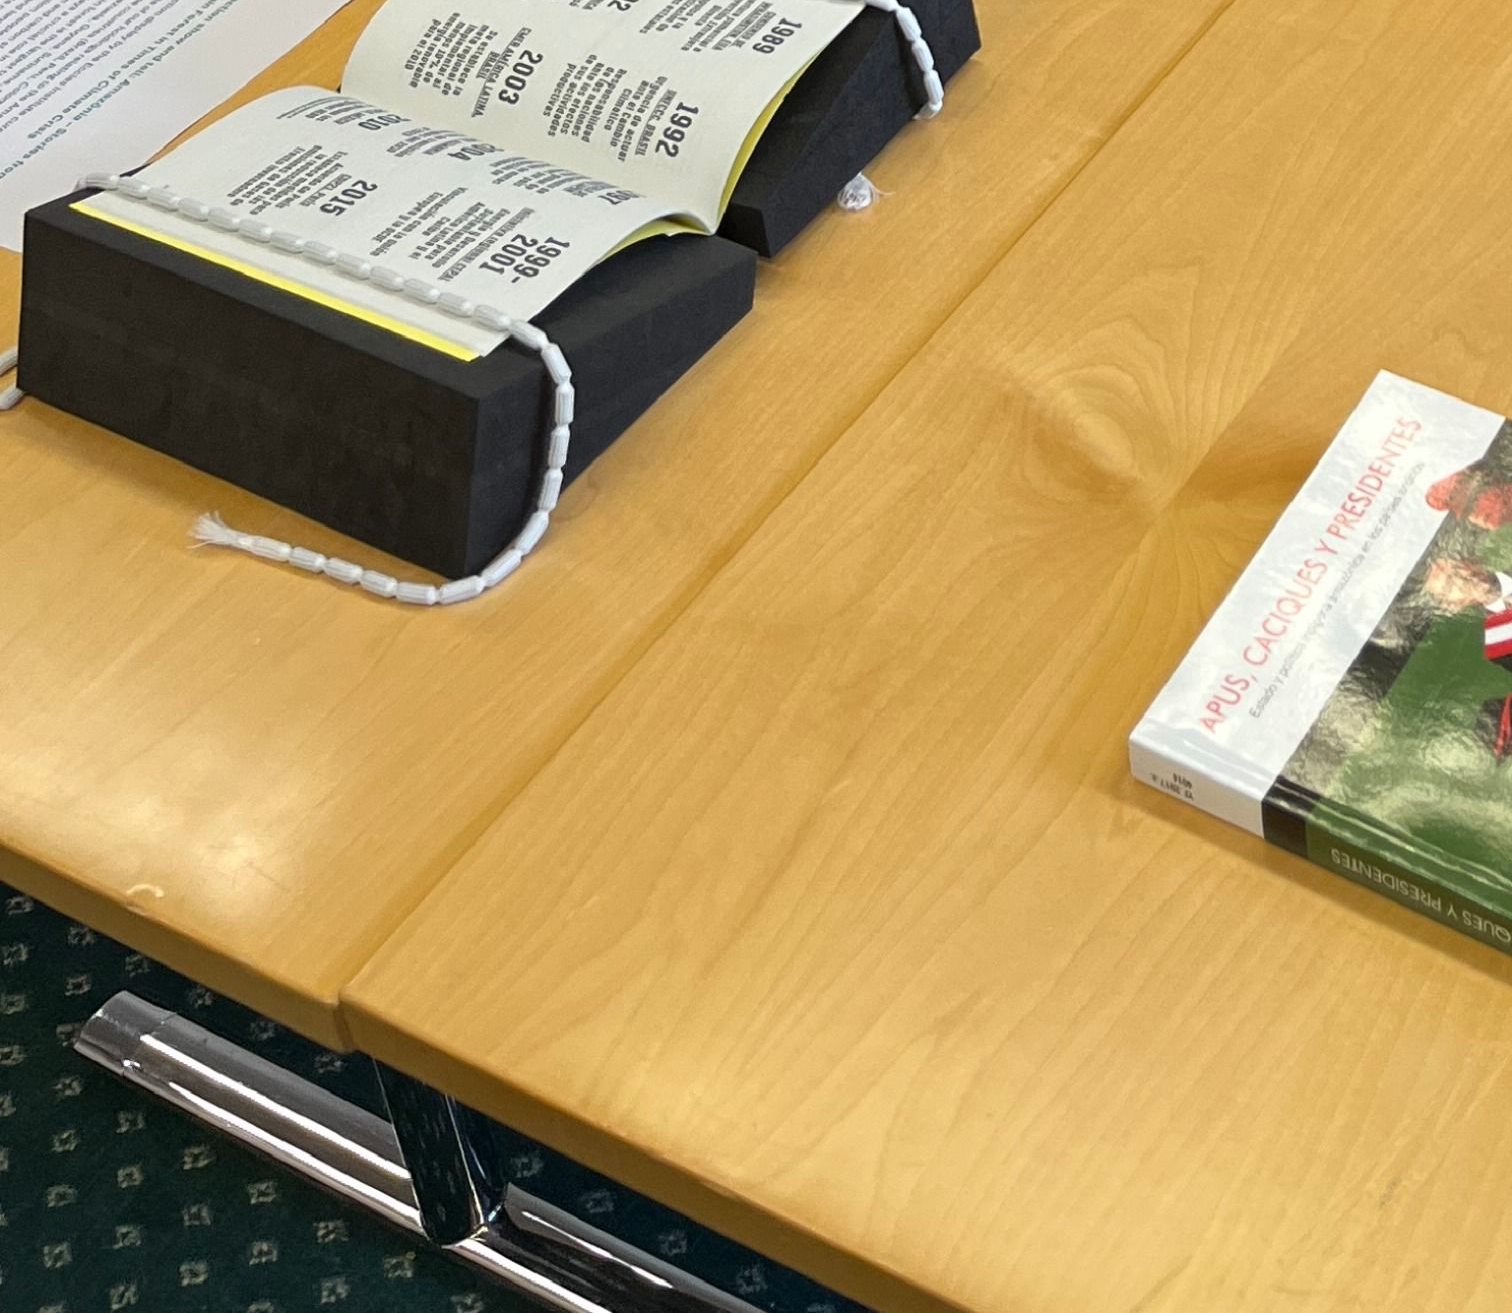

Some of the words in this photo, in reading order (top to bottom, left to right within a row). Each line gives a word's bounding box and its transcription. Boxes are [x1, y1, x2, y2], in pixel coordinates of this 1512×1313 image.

[120, 15, 155, 41] display
[166, 9, 204, 36] Forest
[175, 23, 205, 45] show
[423, 18, 442, 39] para
[467, 24, 489, 45] meta
[752, 14, 802, 54] 1989
[107, 40, 124, 50] by
[151, 44, 175, 61] and
[153, 36, 169, 44] in
[416, 38, 428, 48] el
[90, 49, 111, 62] the
[120, 45, 157, 69] Times
[403, 48, 423, 70] 2010
[408, 42, 437, 88] renovable
[445, 43, 472, 82] regional
[457, 41, 489, 84] establece
[475, 50, 499, 80] BRASIL
[584, 53, 598, 65] de
[107, 69, 122, 79] of
[128, 61, 155, 78] tell:
[422, 70, 434, 83] de
[487, 49, 543, 105] 2003
[573, 65, 589, 81] sus
[602, 66, 615, 78] de
[18, 86, 62, 116] Institute
[61, 79, 110, 114] Climate
[72, 78, 131, 121] Amazônia
[440, 82, 452, 96] de
[451, 85, 463, 96] la
[542, 62, 577, 117] productivas
[547, 81, 578, 137] actividades
[570, 93, 597, 137] naciones
[580, 68, 627, 143] Responsabilidad
[625, 100, 637, 111] el
[27, 114, 64, 139] Crisis
[609, 111, 632, 148] Cambio
[629, 114, 642, 128] de
[654, 102, 699, 158] 1992
[22, 127, 67, 159] Stories
[616, 128, 635, 162] actuar
[319, 179, 378, 216] 2015
[478, 233, 539, 275] 2001
[511, 238, 570, 283] 1999-
[1200, 674, 1258, 732] APUS,
[1242, 558, 1327, 667] CACIQUES
[1313, 538, 1339, 556] Y
[1326, 420, 1421, 540] PRESIDENTES
[1331, 848, 1442, 912] PRESIDENTES
[1446, 902, 1458, 920] Y
